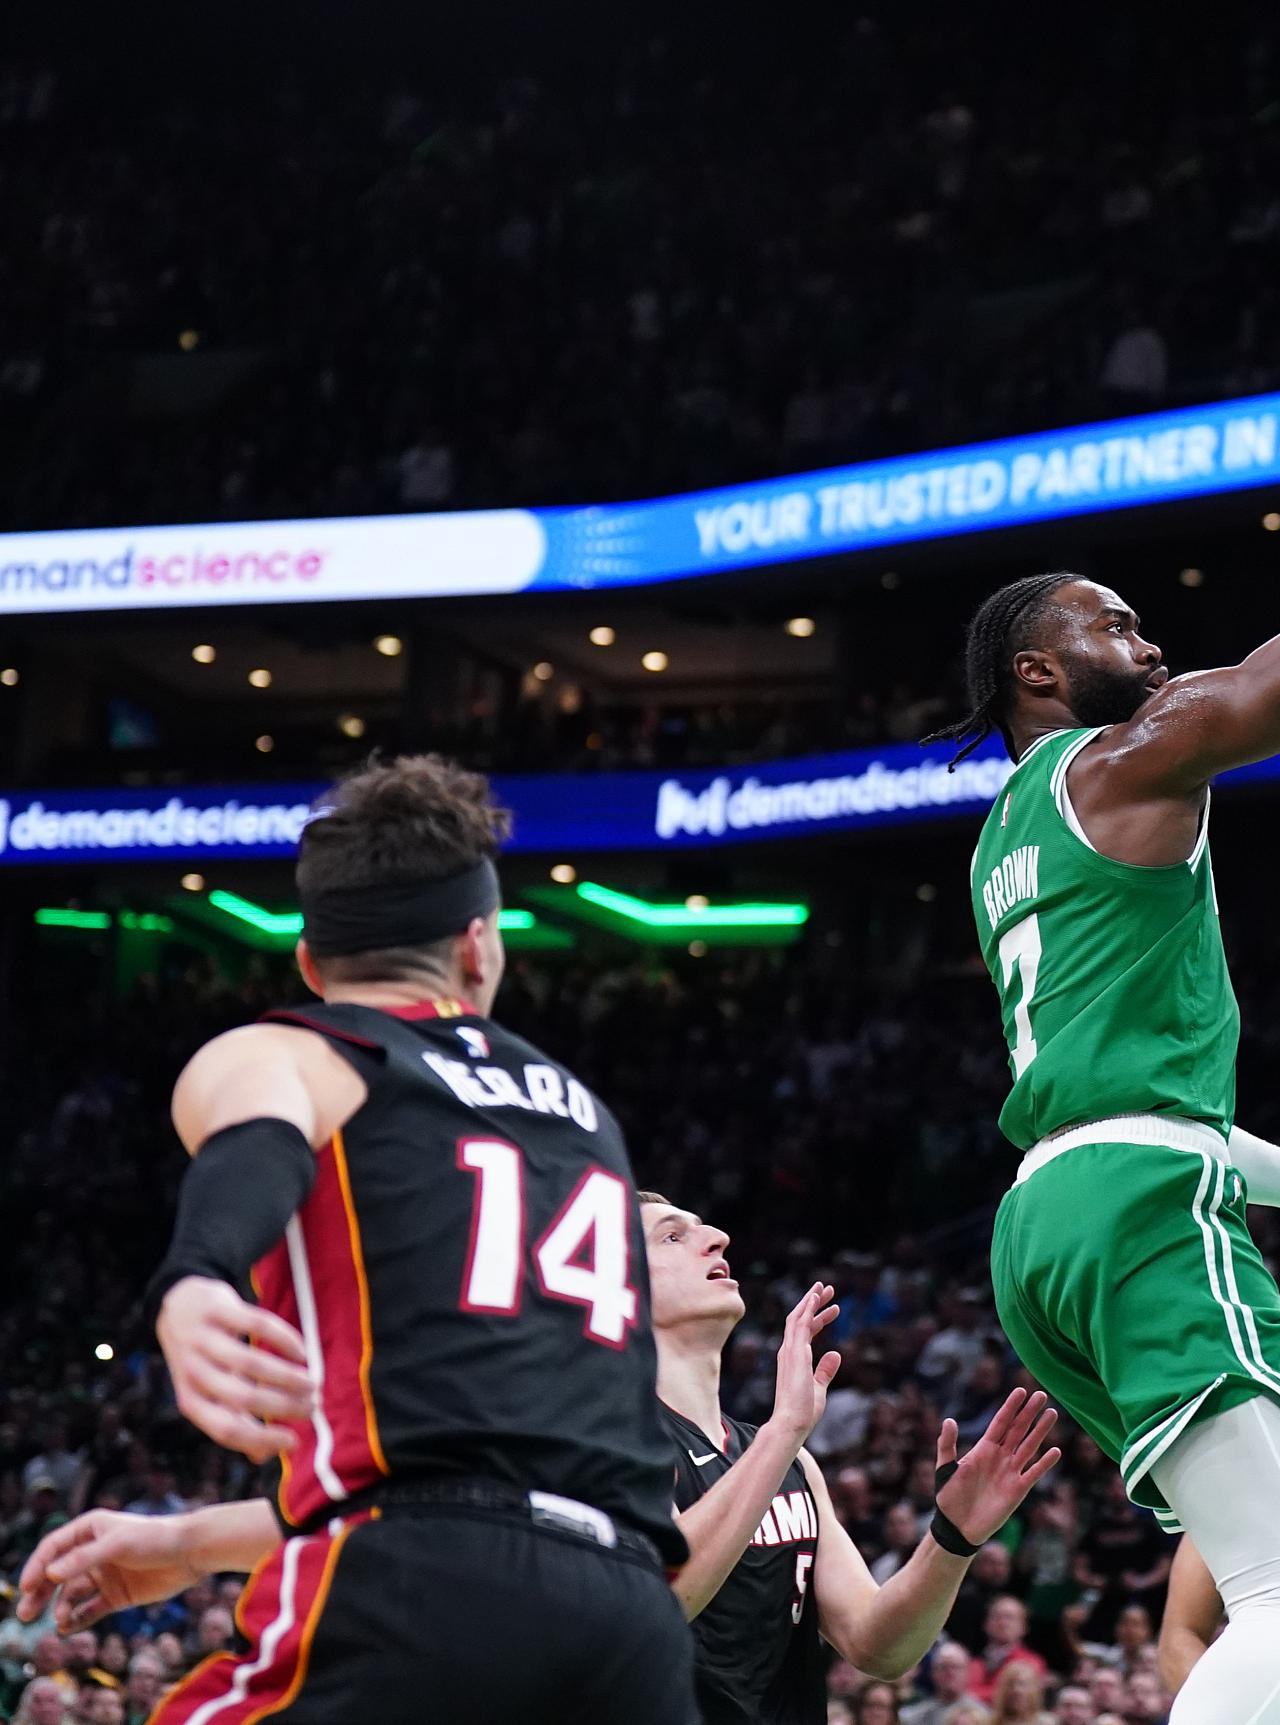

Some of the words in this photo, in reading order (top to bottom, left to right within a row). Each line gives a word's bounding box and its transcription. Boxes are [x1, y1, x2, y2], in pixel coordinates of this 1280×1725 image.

[695, 492, 811, 556] YOUR
[816, 460, 1007, 535] TRUSTED
[1010, 423, 1218, 505] PARTNER
[1222, 414, 1277, 470] IN
[0, 546, 323, 593] mandscience
[10, 797, 312, 850] demandscienc
[727, 757, 1017, 829] demandscienc
[983, 845, 1040, 931] BROWN
[999, 913, 1042, 1082] 7
[456, 1135, 641, 1350] 14
